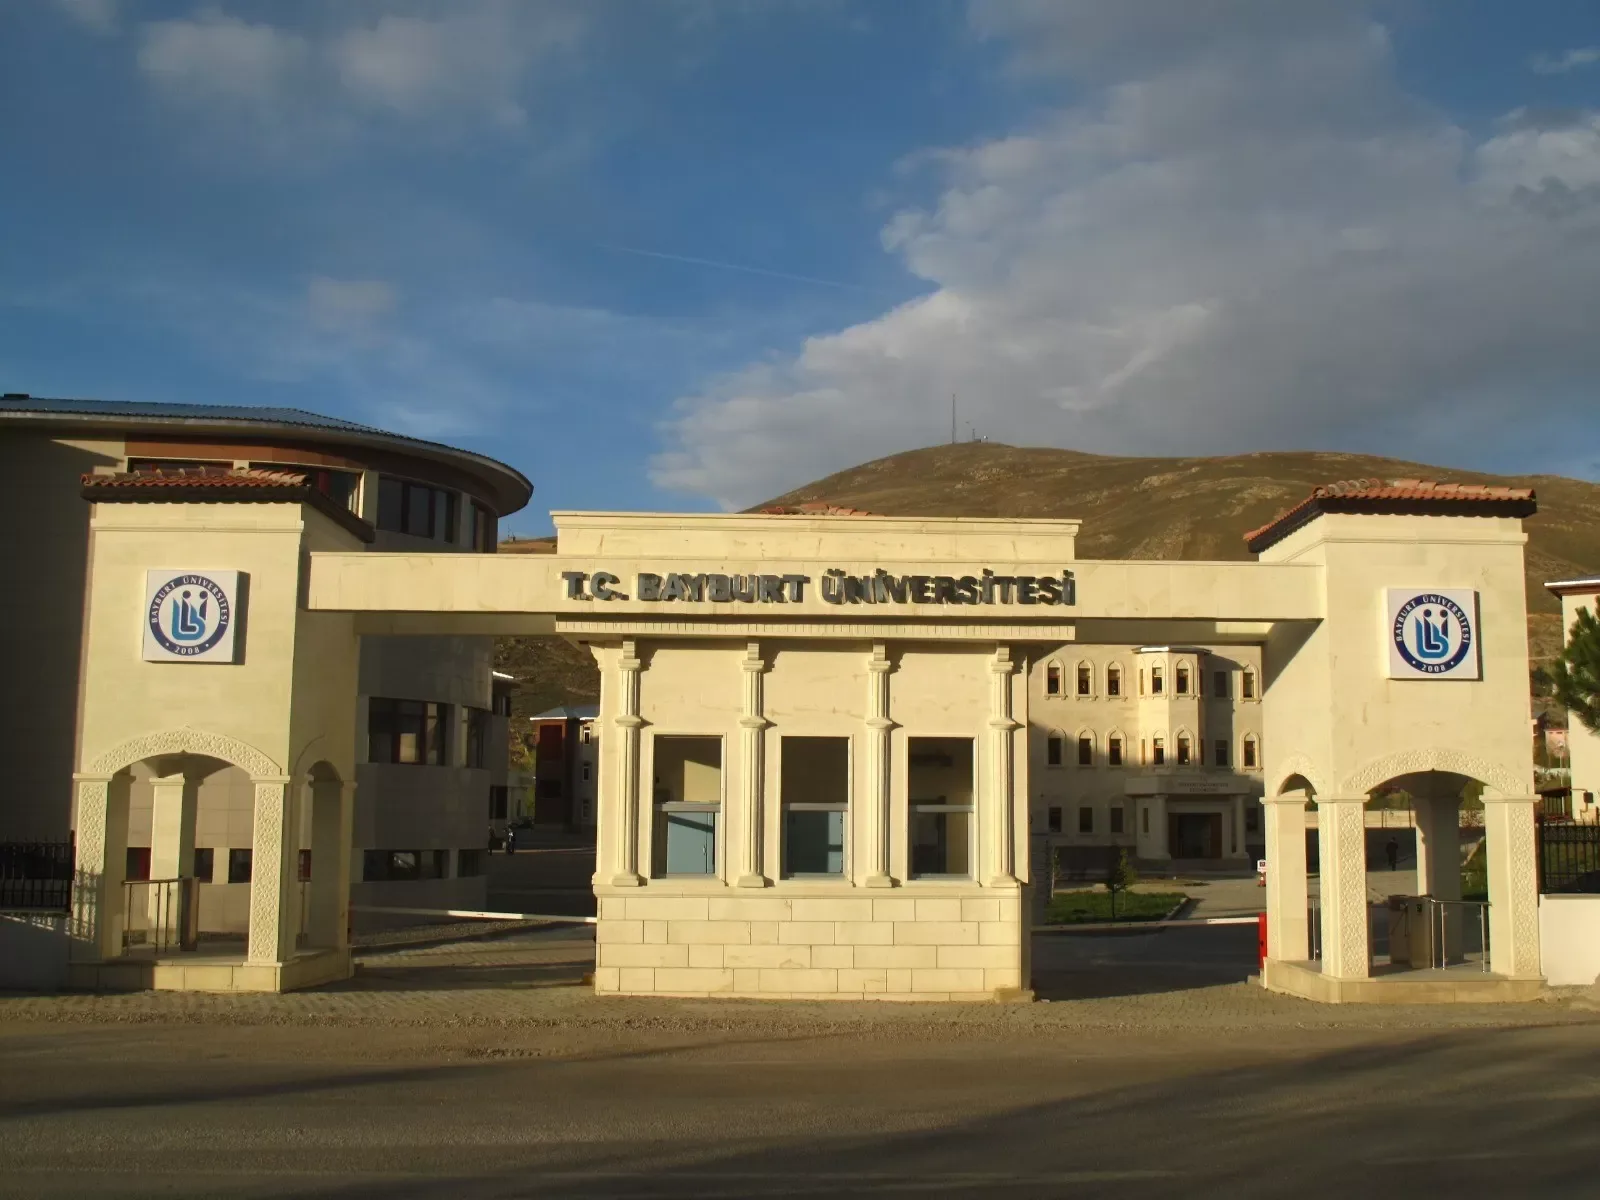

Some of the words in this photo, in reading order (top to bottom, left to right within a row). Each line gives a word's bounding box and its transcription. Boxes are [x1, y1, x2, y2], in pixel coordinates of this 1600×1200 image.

[151, 582, 176, 624] BAYBURT
[637, 573, 811, 603] BAYBURT
[821, 568, 1076, 606] ÜNİVERSİTESİ
[1395, 601, 1417, 642] BAYBURT
[174, 646, 200, 655] 2008
[1421, 664, 1446, 673] 2008
